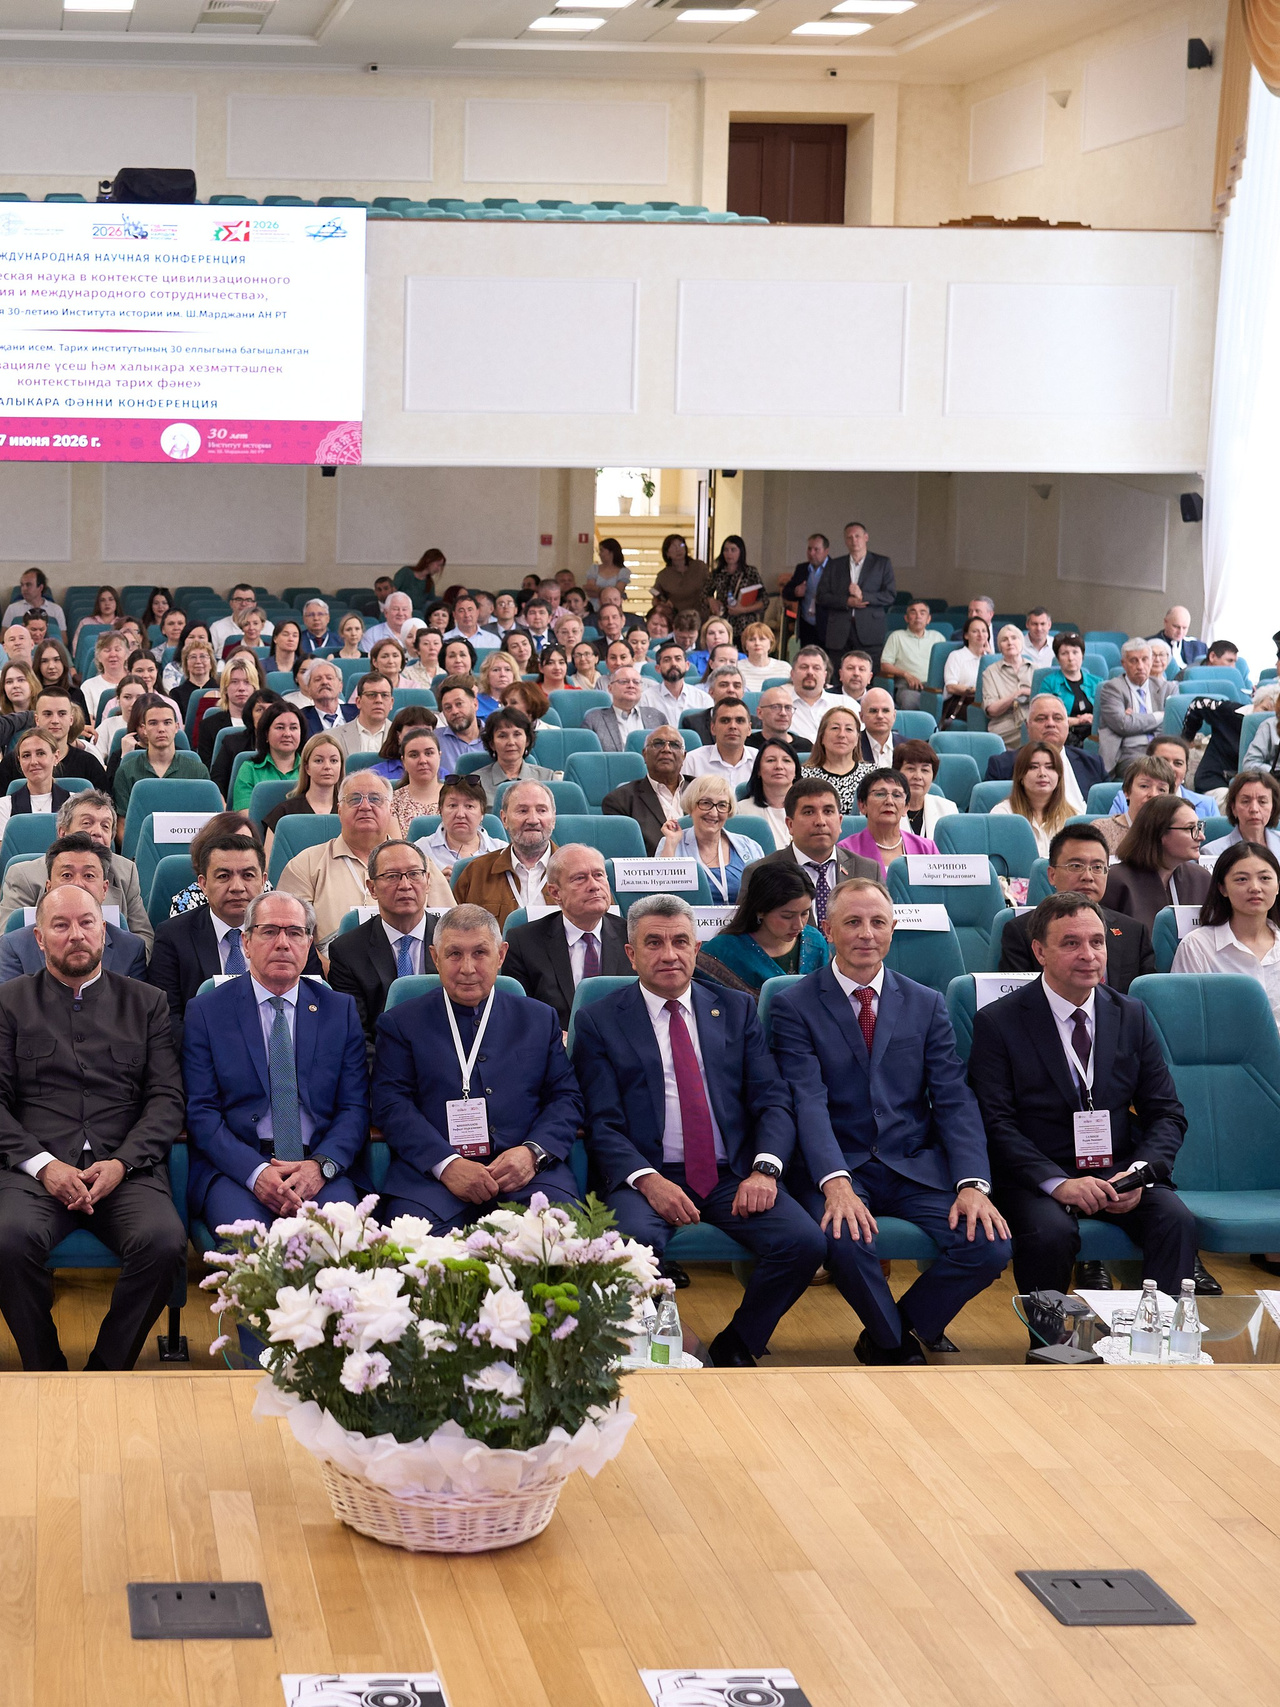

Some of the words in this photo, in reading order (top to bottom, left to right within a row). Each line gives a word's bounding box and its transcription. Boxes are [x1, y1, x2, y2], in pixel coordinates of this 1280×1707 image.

[253, 220, 280, 229] 2026
[92, 226, 123, 237] 2026
[94, 253, 150, 263] НАУЧНАЯ
[154, 254, 246, 265] КОНФЕРЕНЦИЯ
[37, 273, 76, 283] наука
[80, 273, 87, 281] в
[91, 273, 158, 283] контексте
[162, 275, 291, 285] цивилизационного
[19, 289, 27, 297] и
[31, 289, 146, 300] международного
[150, 290, 268, 301] сотрудничества»,
[7, 308, 59, 317] 30-летию
[62, 308, 116, 319] Института
[119, 310, 163, 319] истории
[166, 310, 183, 318] им.
[186, 310, 255, 320] Ш.Марджани
[258, 311, 272, 319] АН
[275, 311, 288, 319] РТ
[28, 344, 56, 352] исем.
[59, 344, 89, 353] Тарих
[91, 345, 167, 354] институтының
[170, 345, 182, 353] 30
[185, 346, 237, 354] еллыгына
[240, 345, 309, 355] багышланган
[55, 362, 87, 373] үсеш
[91, 361, 116, 371] һәм
[120, 364, 185, 374] халыкара
[189, 364, 283, 374] хезмәттәшлек
[17, 378, 111, 388] контекстында
[116, 379, 153, 390] тарих
[157, 378, 201, 390] фәне»
[65, 398, 113, 407] ФӘННИ
[118, 399, 218, 409] КОНФЕРЕНЦИЯ
[207, 428, 228, 439] 30
[9, 436, 50, 447] июня
[52, 434, 88, 447] 2026
[91, 436, 101, 447] г.
[623, 868, 687, 877] МОТЫГУЛЛИН
